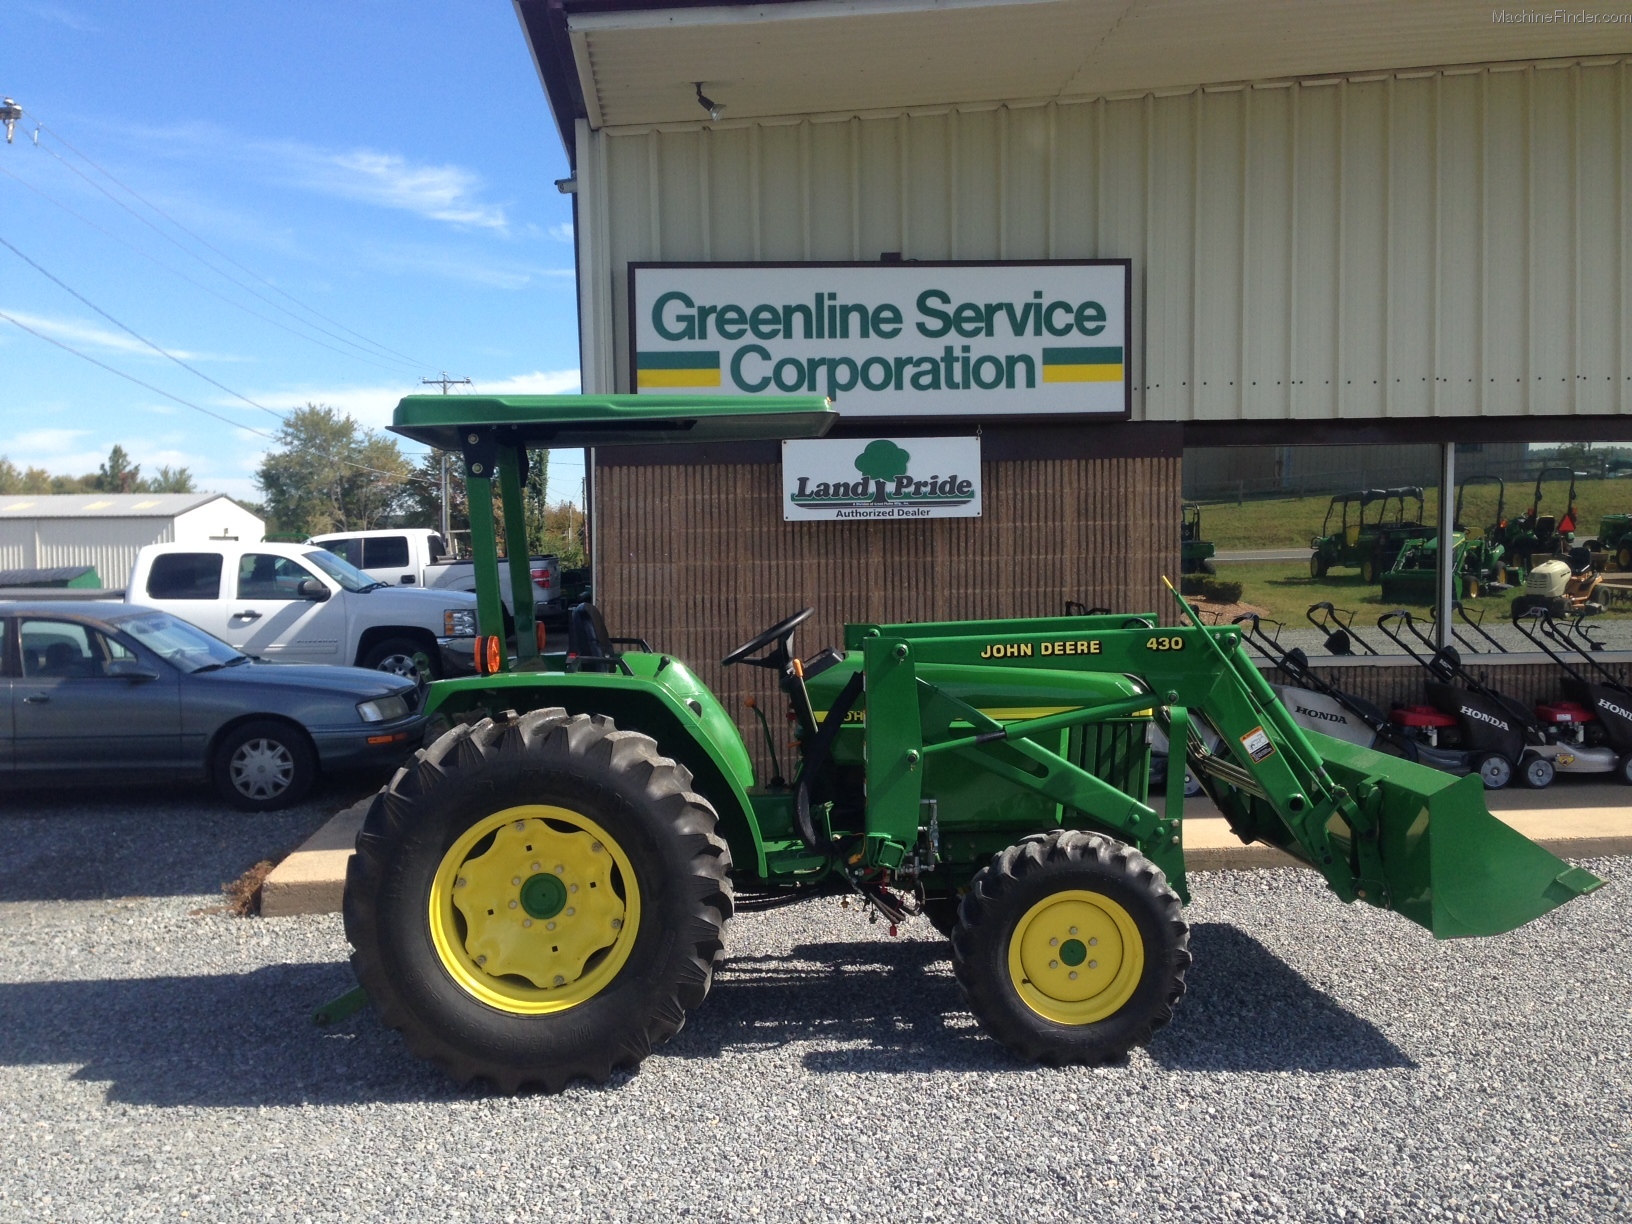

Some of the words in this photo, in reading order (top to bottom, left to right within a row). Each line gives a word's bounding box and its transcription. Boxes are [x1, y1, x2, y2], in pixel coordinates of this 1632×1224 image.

[652, 291, 903, 341] Greenline
[915, 289, 1107, 338] Service
[730, 344, 1036, 401] Corporation
[794, 476, 870, 499] Land
[892, 475, 972, 497] Pride
[836, 508, 895, 518] Authorized
[898, 507, 931, 517] Dealer
[980, 643, 1033, 658] JOHN
[1040, 640, 1101, 656] DEERE
[1146, 637, 1184, 651] 430
[1295, 705, 1348, 725] HONDA
[1460, 705, 1509, 731] HONDA
[1597, 698, 1632, 721] HON
